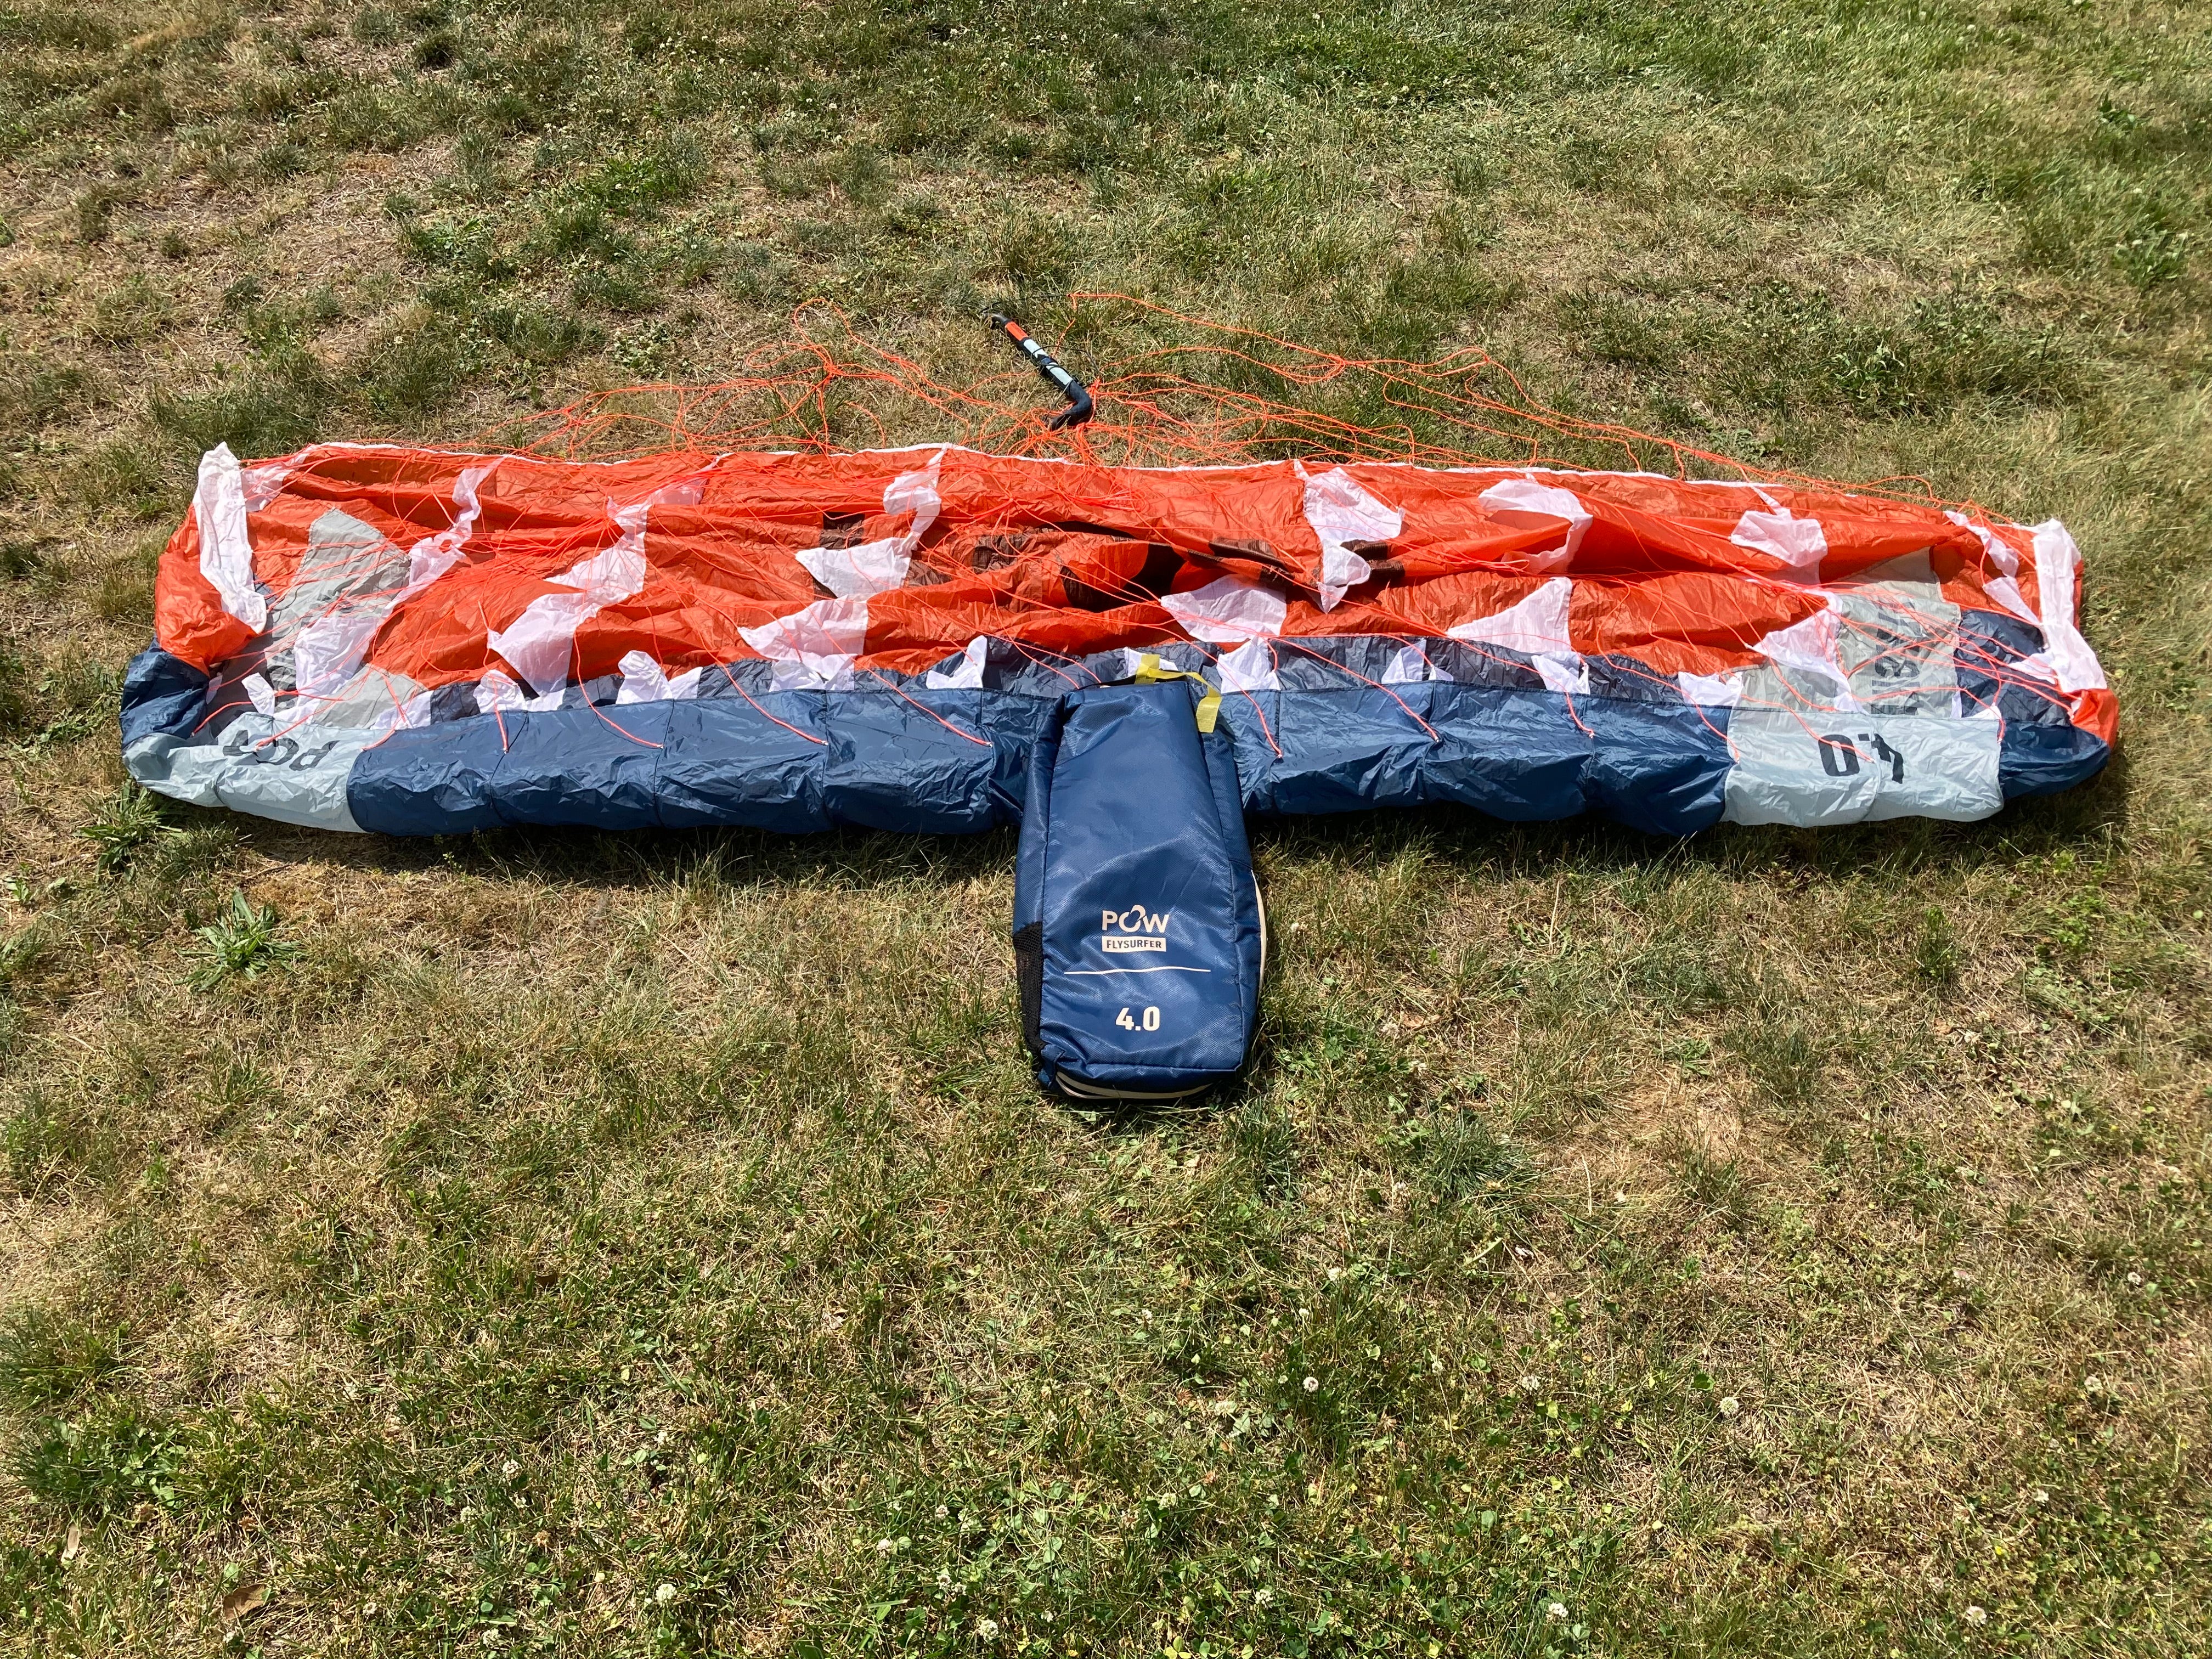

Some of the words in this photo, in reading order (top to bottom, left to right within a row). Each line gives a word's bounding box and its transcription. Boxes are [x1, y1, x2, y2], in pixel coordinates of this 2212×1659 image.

[1818, 733, 1904, 784] 4.0
[1102, 904, 1170, 933] POW
[1106, 939, 1162, 949] FLYSURFER
[1115, 1006, 1160, 1031] 4.0
